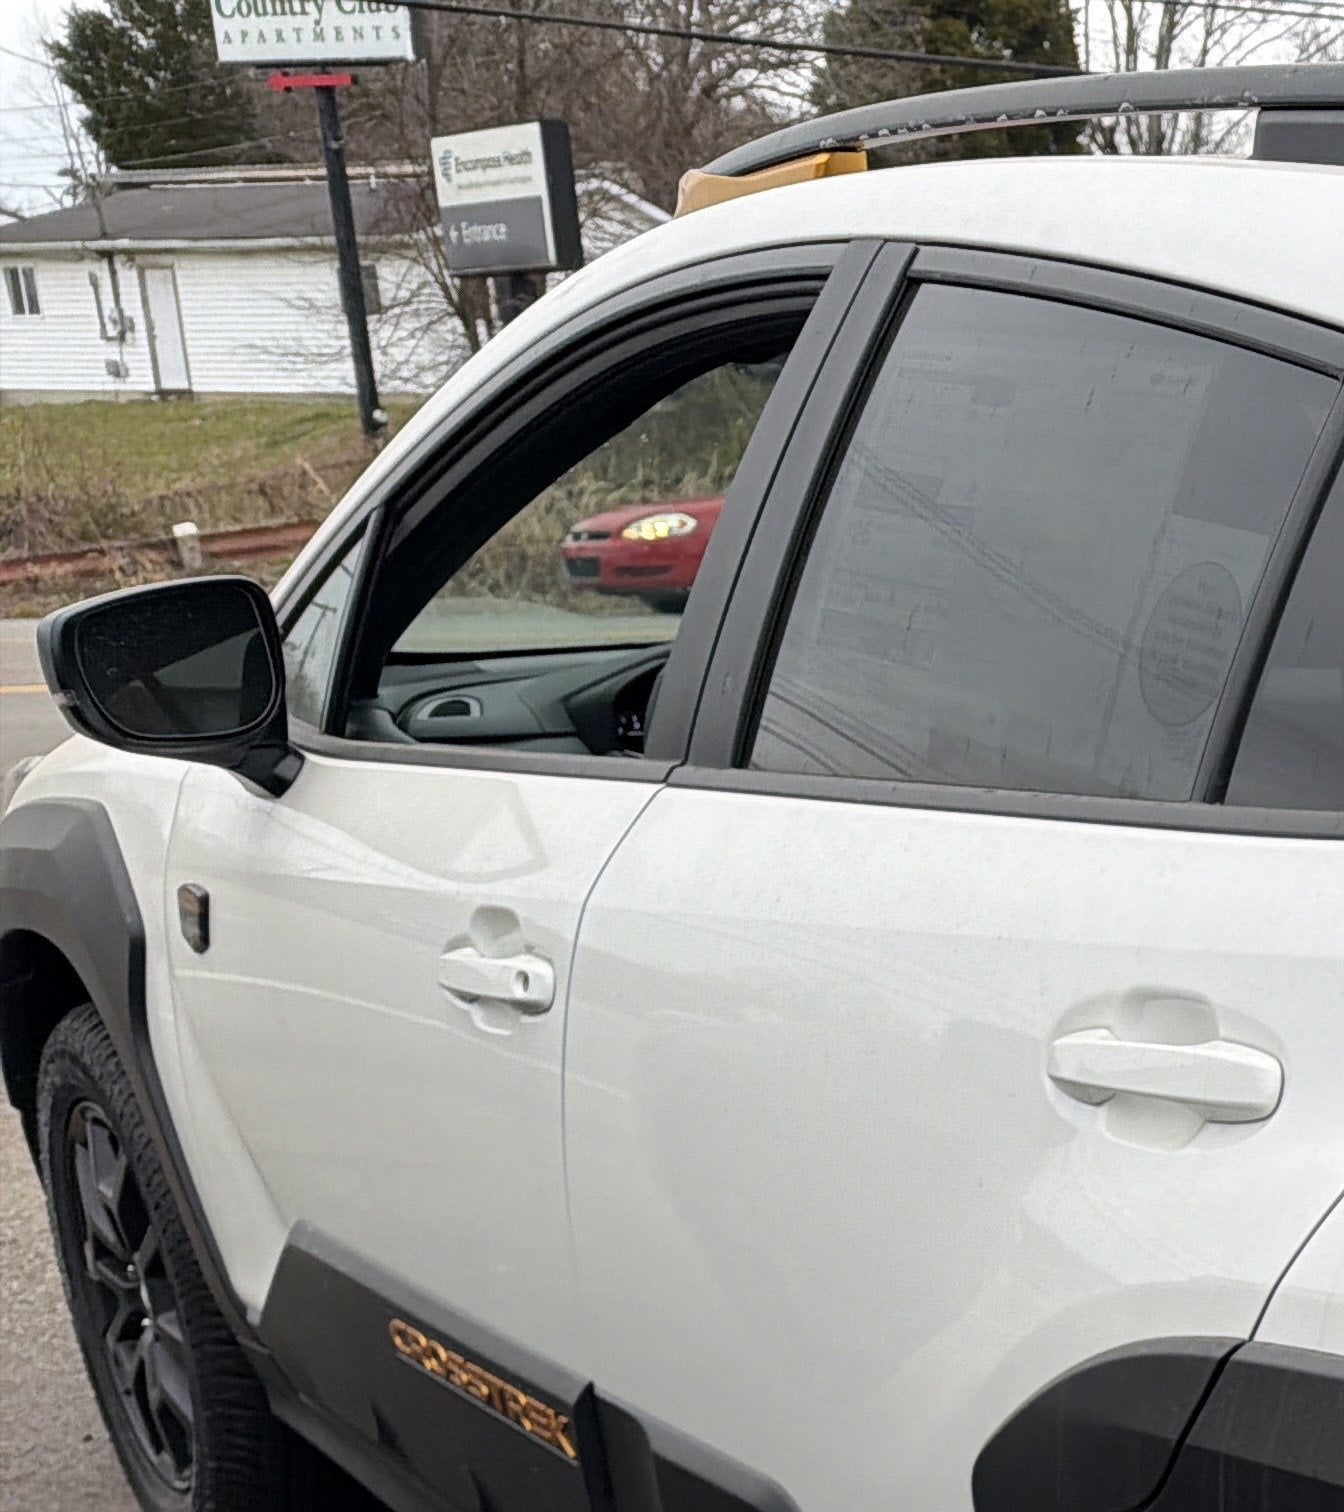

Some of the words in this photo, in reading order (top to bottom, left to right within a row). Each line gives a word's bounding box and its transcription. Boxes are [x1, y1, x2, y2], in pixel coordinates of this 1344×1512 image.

[215, 0, 325, 26] Country
[222, 25, 401, 45] APARTMENTS
[389, 1318, 577, 1459] CROSSTREK
